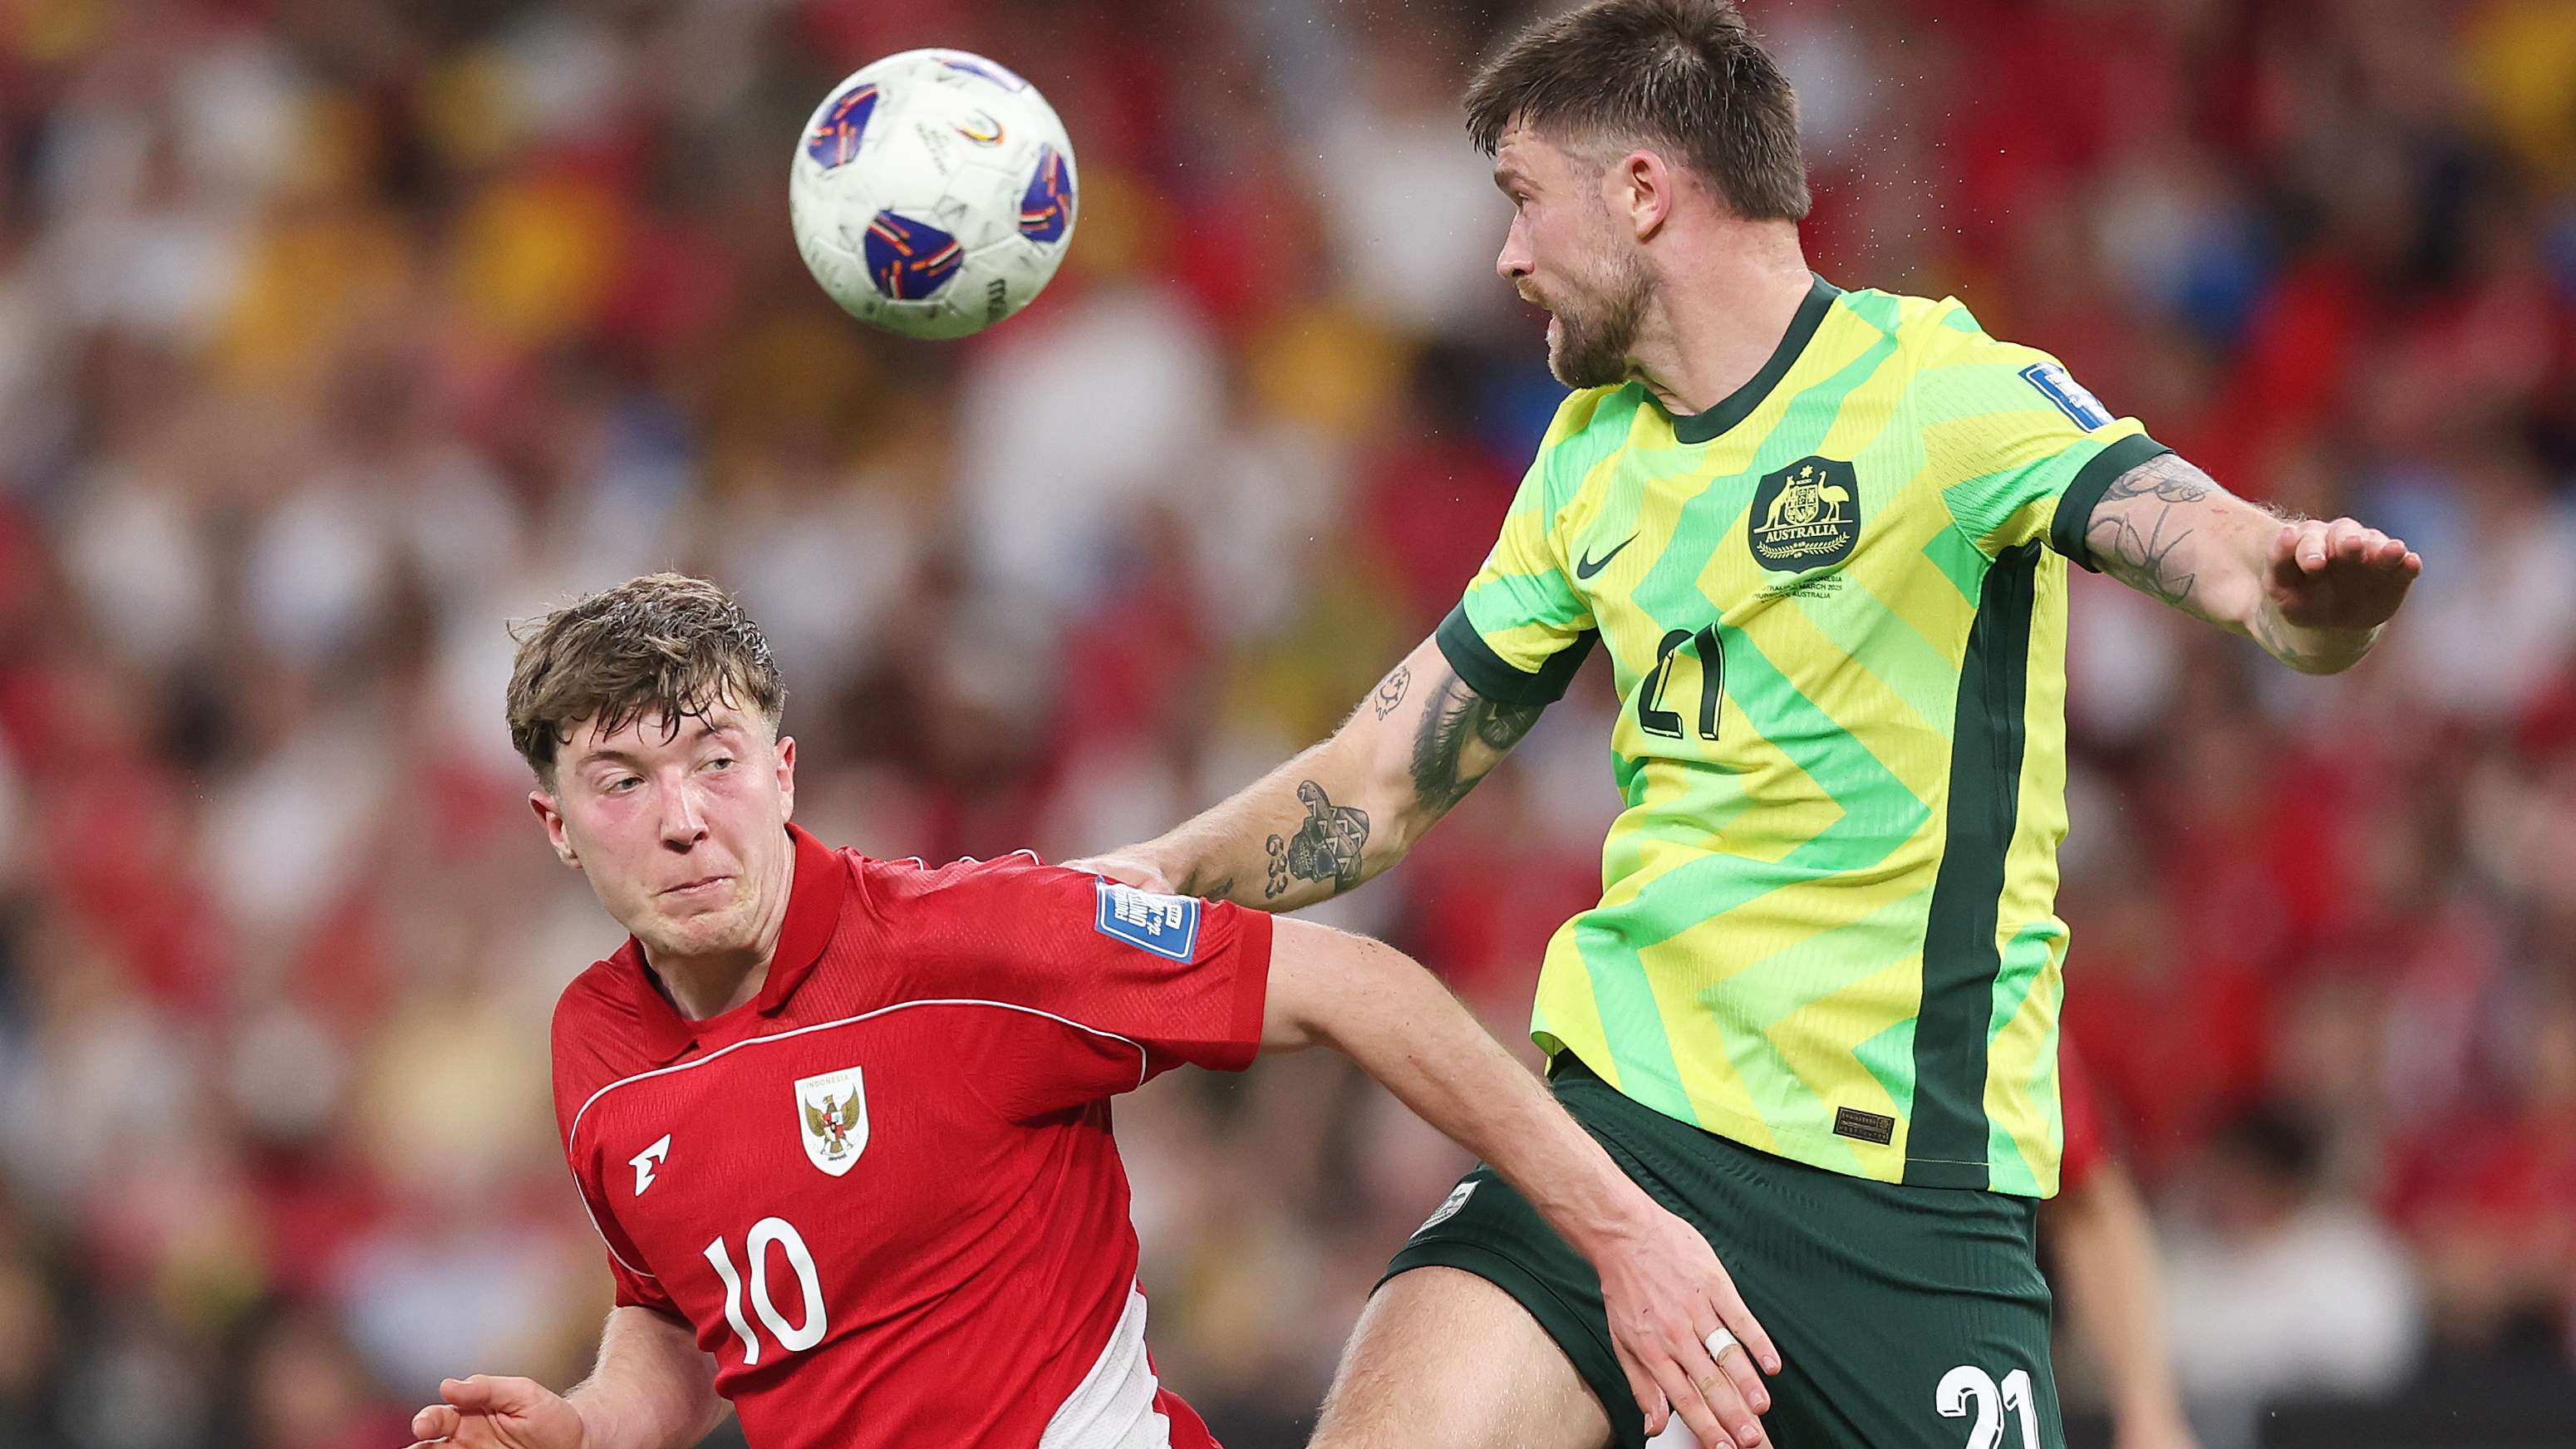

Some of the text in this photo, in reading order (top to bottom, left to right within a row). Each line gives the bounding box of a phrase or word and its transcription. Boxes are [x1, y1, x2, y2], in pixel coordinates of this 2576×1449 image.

[1766, 524, 1839, 543] AUSTRALIA
[1638, 620, 1727, 741] 21
[1147, 915, 1163, 936] the
[806, 1074, 849, 1088] INDONESIA
[703, 1216, 828, 1365] 10
[1935, 1365, 2041, 1449] 21
